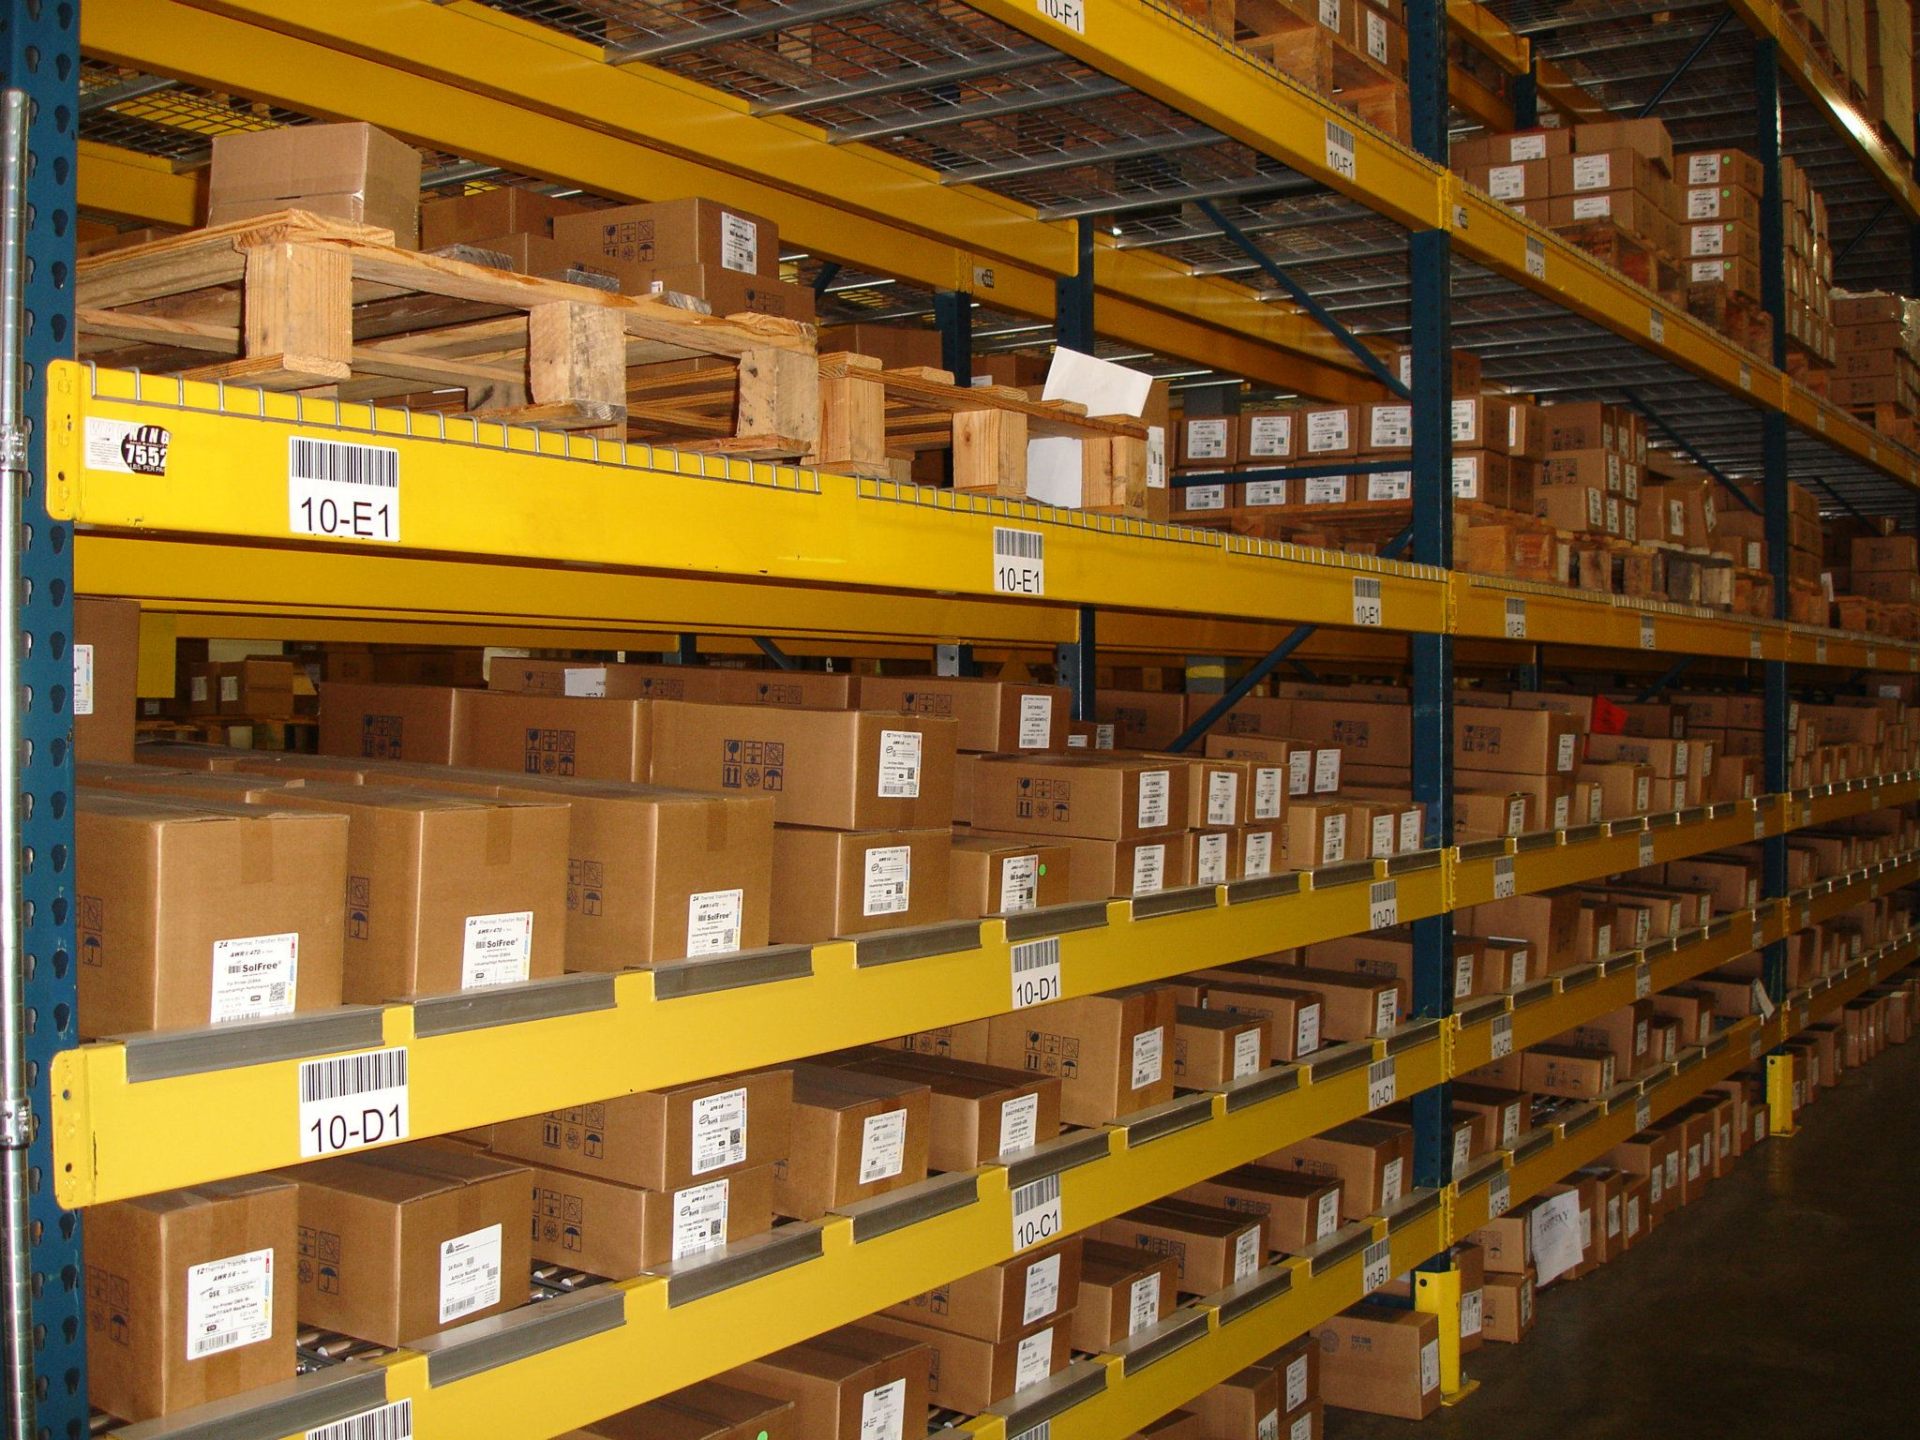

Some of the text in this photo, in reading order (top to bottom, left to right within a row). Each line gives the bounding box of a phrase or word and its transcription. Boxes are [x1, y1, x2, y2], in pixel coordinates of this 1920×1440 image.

[1044, 0, 1080, 32] 10-F1
[1329, 151, 1353, 178] 10-F1
[125, 443, 167, 468] 7552
[301, 496, 389, 538] 10-E1
[999, 567, 1040, 594] 10-E1
[1356, 606, 1379, 625] 10-E1
[1372, 908, 1395, 930] 10-D1
[218, 941, 229, 949] 24
[486, 939, 516, 948] SolFree
[242, 962, 279, 973] SolFree
[1016, 975, 1057, 1007] 10-D1
[1372, 1084, 1394, 1108] 10-C1
[311, 1104, 400, 1153] 10-D1
[1017, 1209, 1059, 1249] 10-C1
[1366, 1264, 1388, 1292] 10-B1
